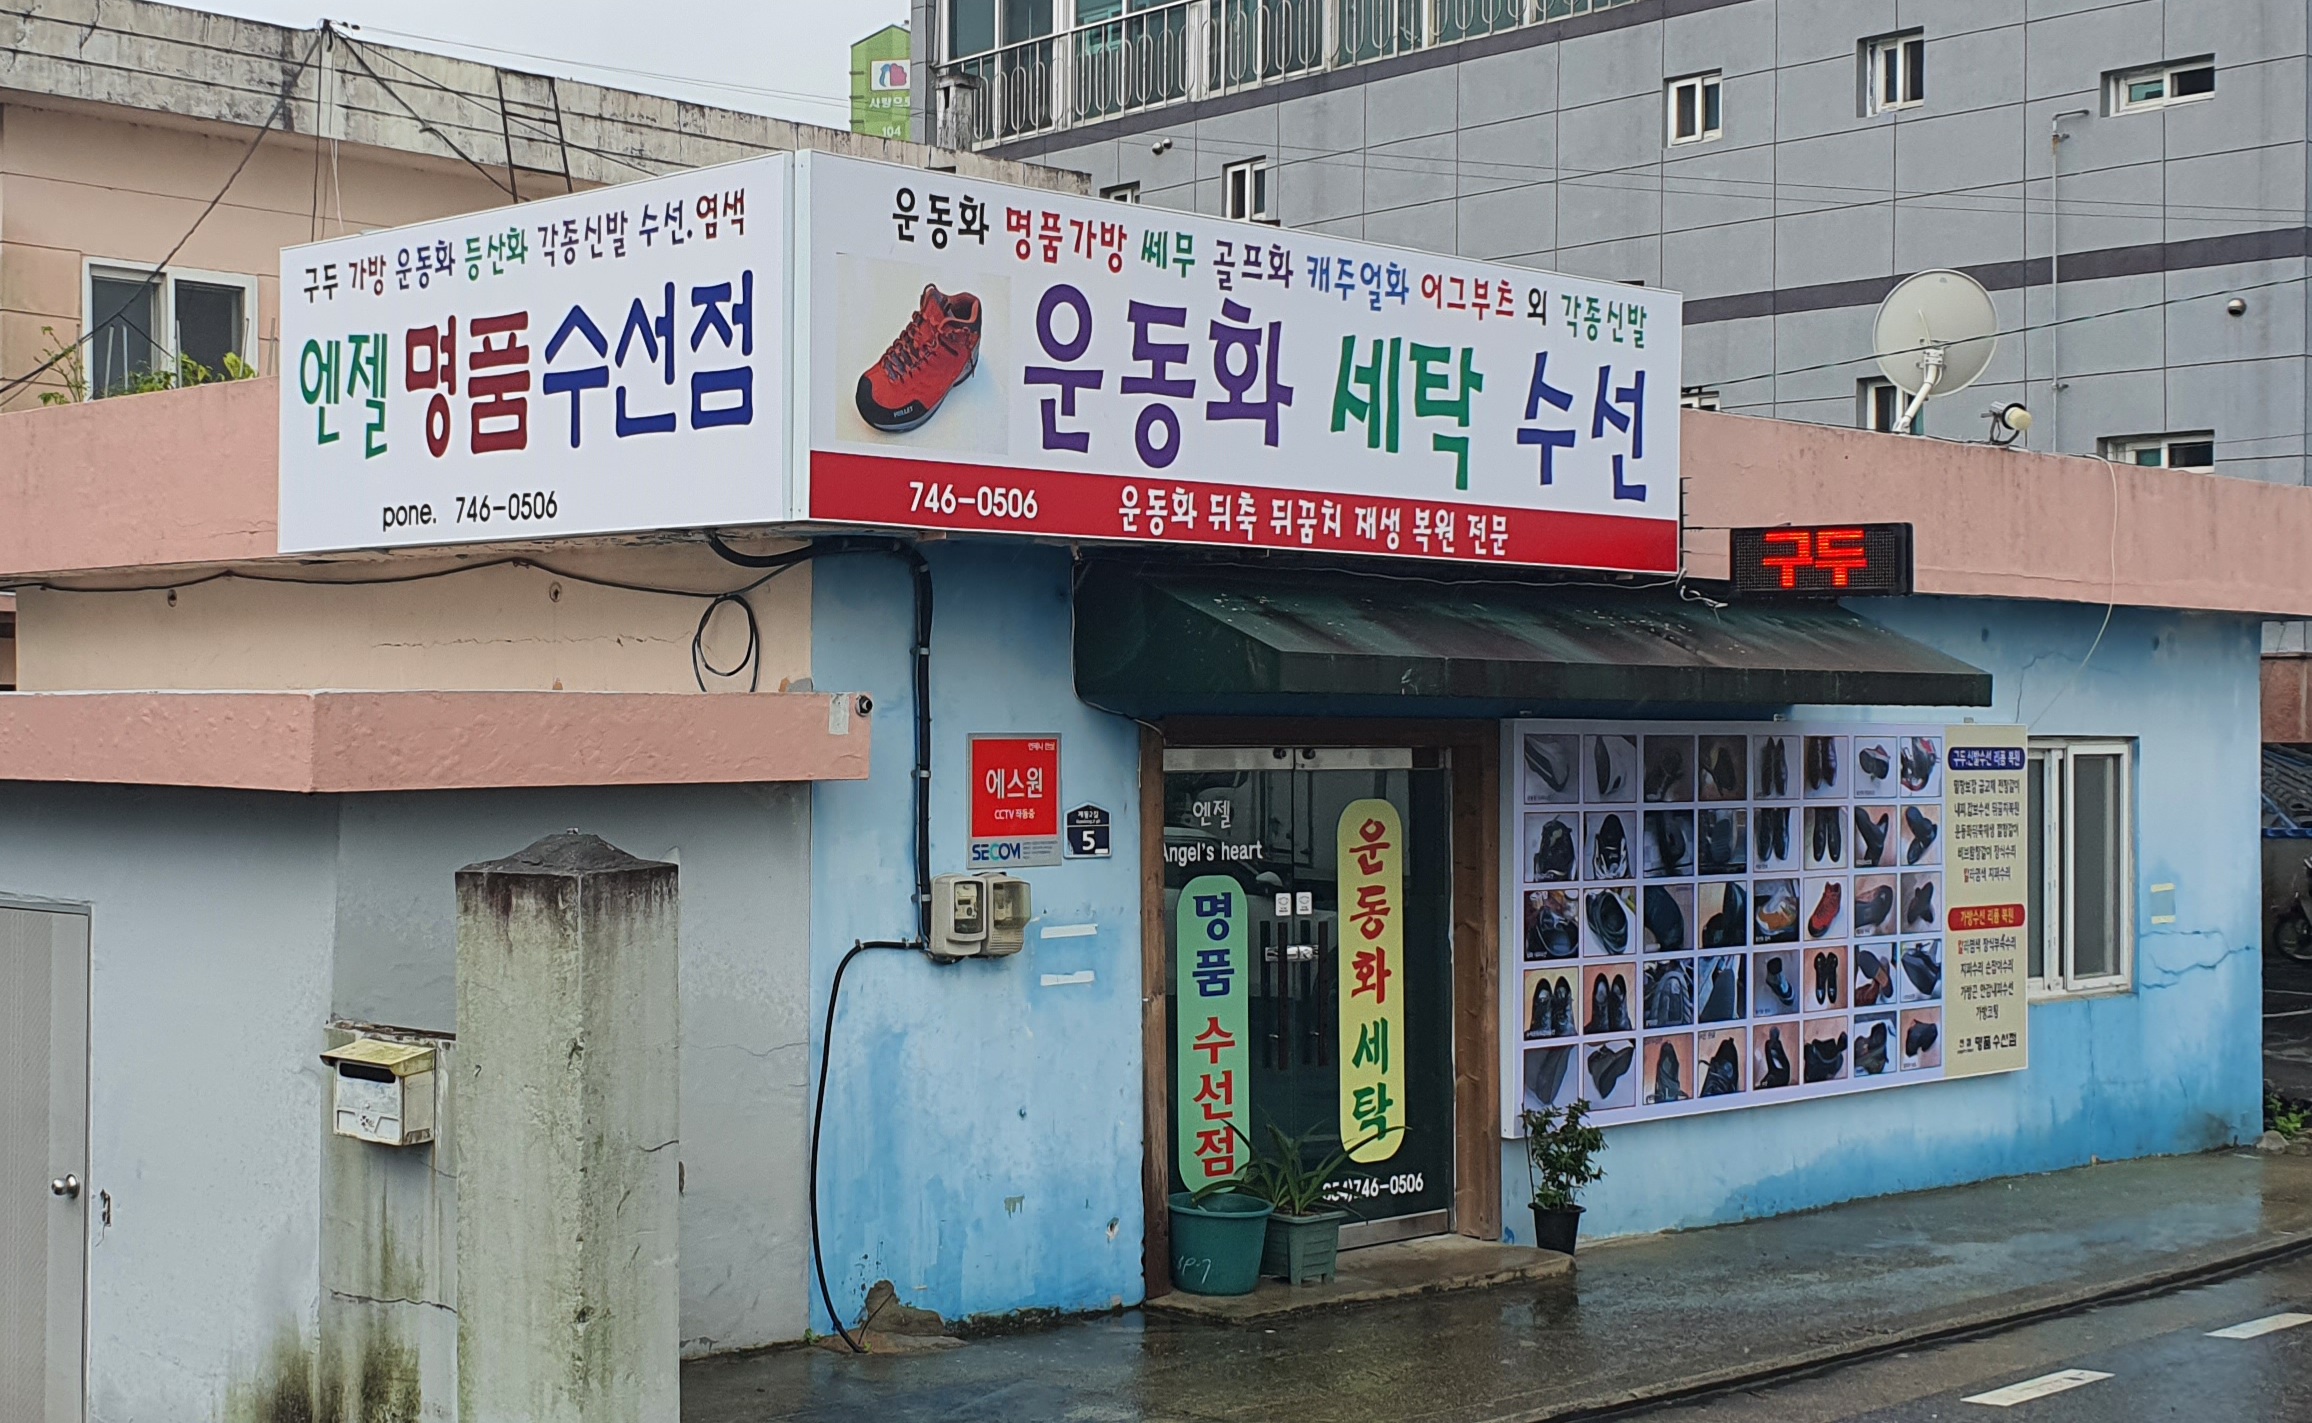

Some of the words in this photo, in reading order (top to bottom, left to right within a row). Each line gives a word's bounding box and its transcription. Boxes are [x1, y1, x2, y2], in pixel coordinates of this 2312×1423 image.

[882, 125, 901, 137] 104
[304, 264, 338, 303] 구두
[349, 255, 386, 295] 가방
[396, 240, 455, 290] 운동화
[465, 227, 528, 281] 등산화
[538, 211, 628, 267] 각종신발
[893, 188, 989, 249] 운동화
[1004, 205, 1128, 274] 명품가방
[1141, 230, 1195, 278] 쎄무
[1213, 240, 1293, 291] 골프화
[1307, 256, 1409, 311] 캐주얼화
[1422, 274, 1514, 320] 어그부츠
[1528, 288, 1547, 325] 외
[1561, 295, 1647, 348] 각종신발
[300, 333, 387, 459] 엔젤
[1024, 283, 1294, 468] 운동화
[1330, 335, 1484, 491] 세탁
[1517, 351, 1647, 502] 수선
[383, 504, 436, 531] pone.
[456, 491, 557, 523] 746-0506
[910, 482, 1037, 518] 746-0506
[1118, 485, 1198, 536] 운동화
[1207, 491, 1257, 541] 뒤축
[1269, 498, 1342, 544] 뒤꿈치
[1354, 507, 1401, 550] 재생
[1412, 508, 1455, 554] 복원
[1467, 514, 1509, 556] 전문
[1762, 529, 1868, 588] 구두
[985, 767, 1043, 799] 에스원
[994, 809, 1015, 820] CCTV
[1015, 808, 1036, 819] 작동중
[1192, 799, 1232, 829] 엔젤
[972, 843, 1021, 861] SECOM
[1082, 830, 1096, 851] 5
[1221, 839, 1264, 861] heart
[1349, 817, 1392, 1005] 운동화
[1192, 891, 1236, 998] 명품
[1192, 1016, 1237, 1178] 수선점
[1351, 1016, 1394, 1140] 세탁
